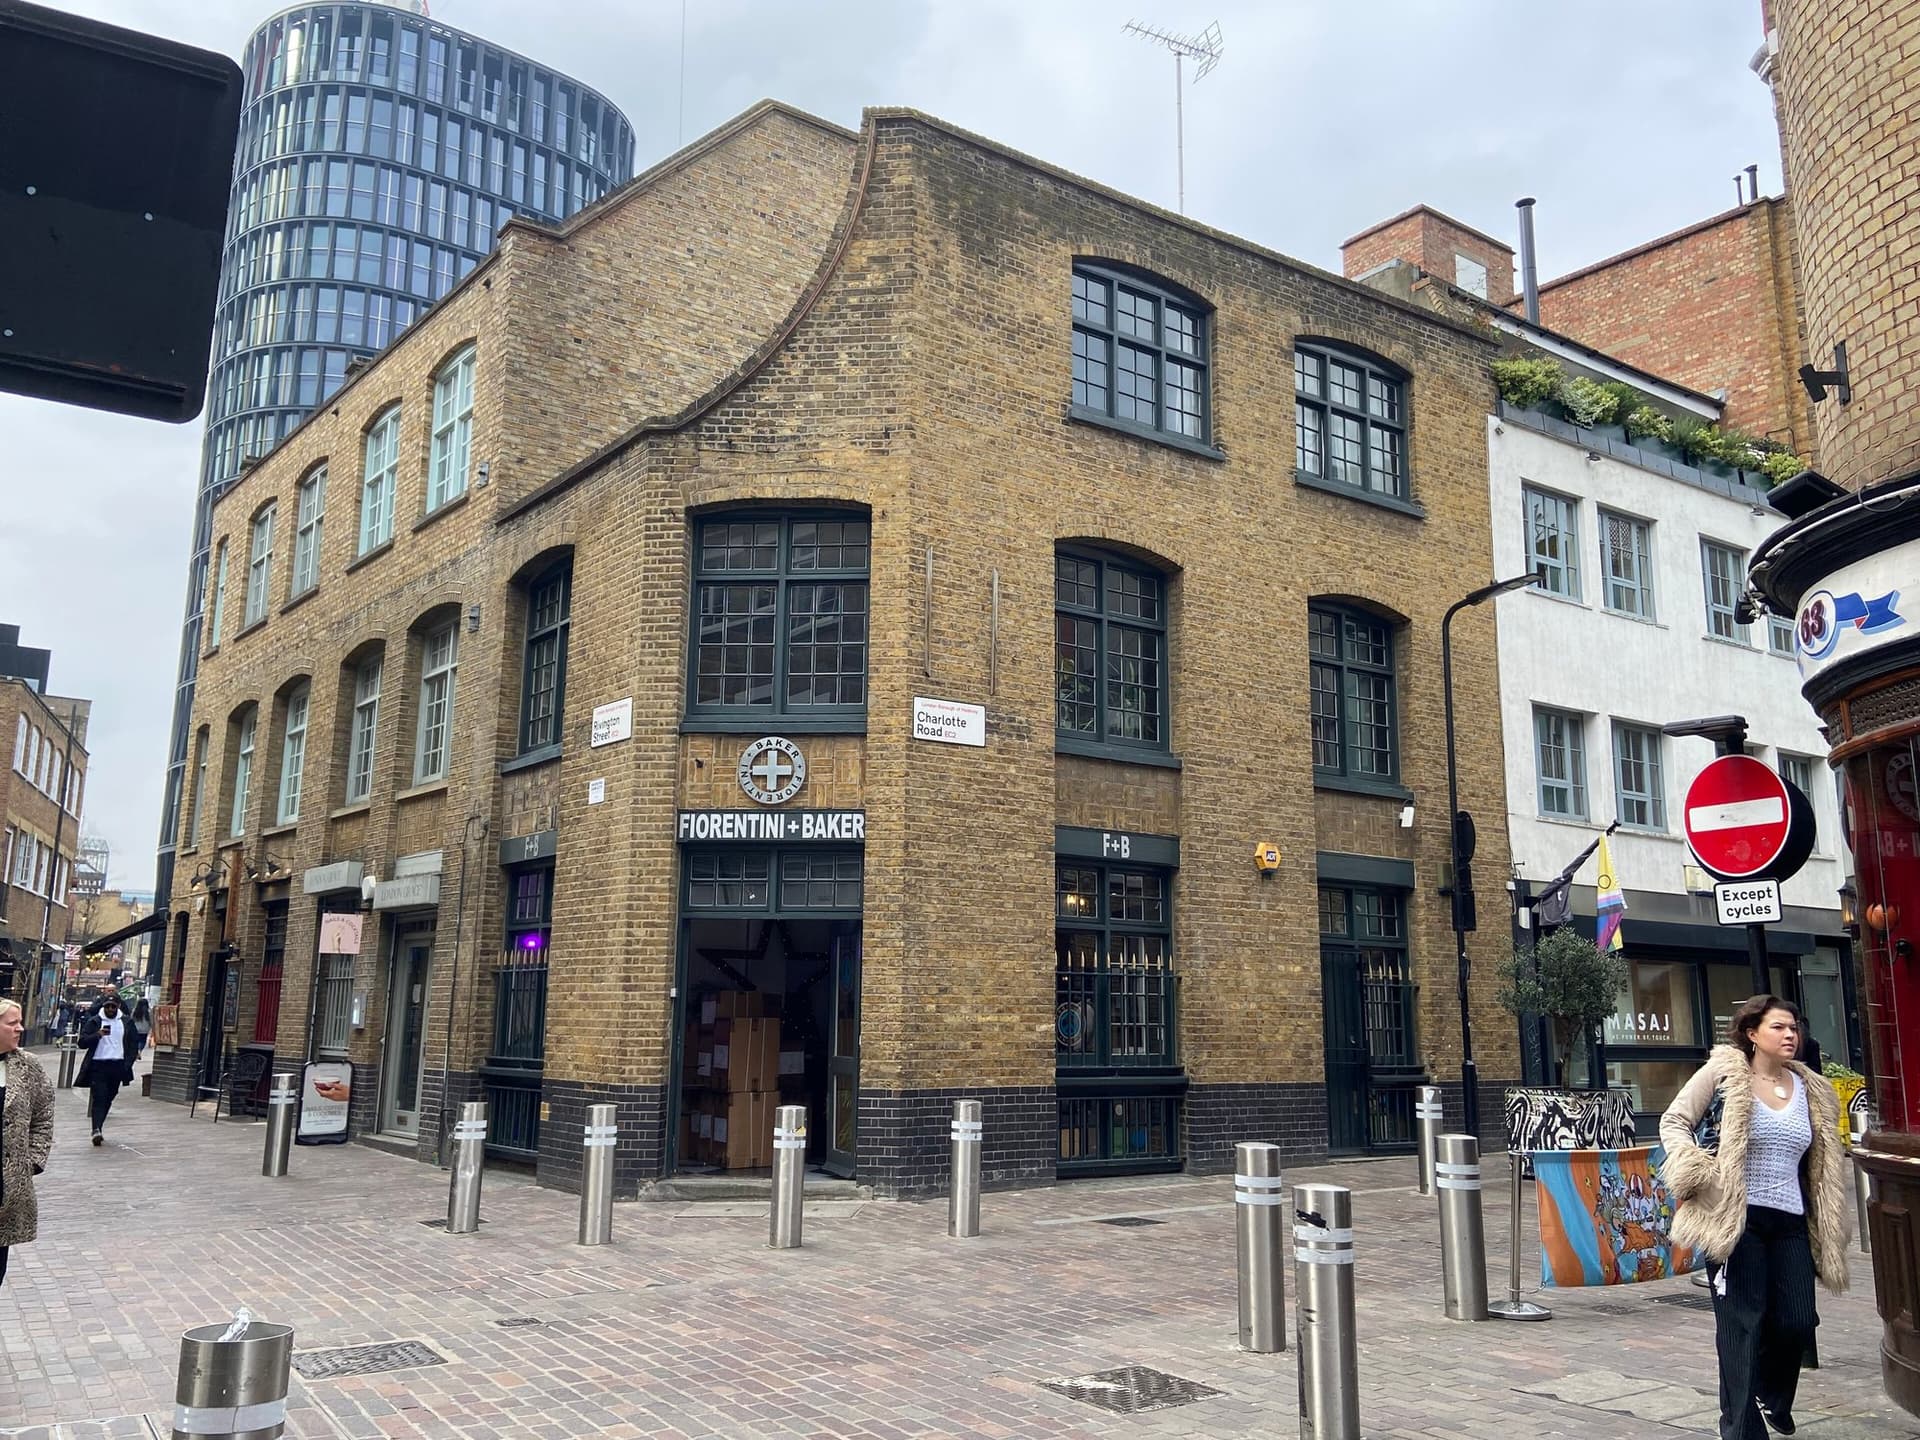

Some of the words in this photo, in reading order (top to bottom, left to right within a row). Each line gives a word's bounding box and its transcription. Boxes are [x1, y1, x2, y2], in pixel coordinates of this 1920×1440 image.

[1801, 600, 1825, 646] 63
[594, 716, 620, 731] Rivington
[917, 711, 967, 728] Charlotte
[593, 730, 611, 743] Street
[917, 723, 943, 737] Road
[944, 730, 956, 738] EC2
[755, 738, 800, 760] BAKER
[740, 763, 803, 802] FIORENTINI
[1721, 886, 1773, 902] Except
[1726, 903, 1772, 919] cycles
[1606, 1012, 1670, 1032] MASAJ
